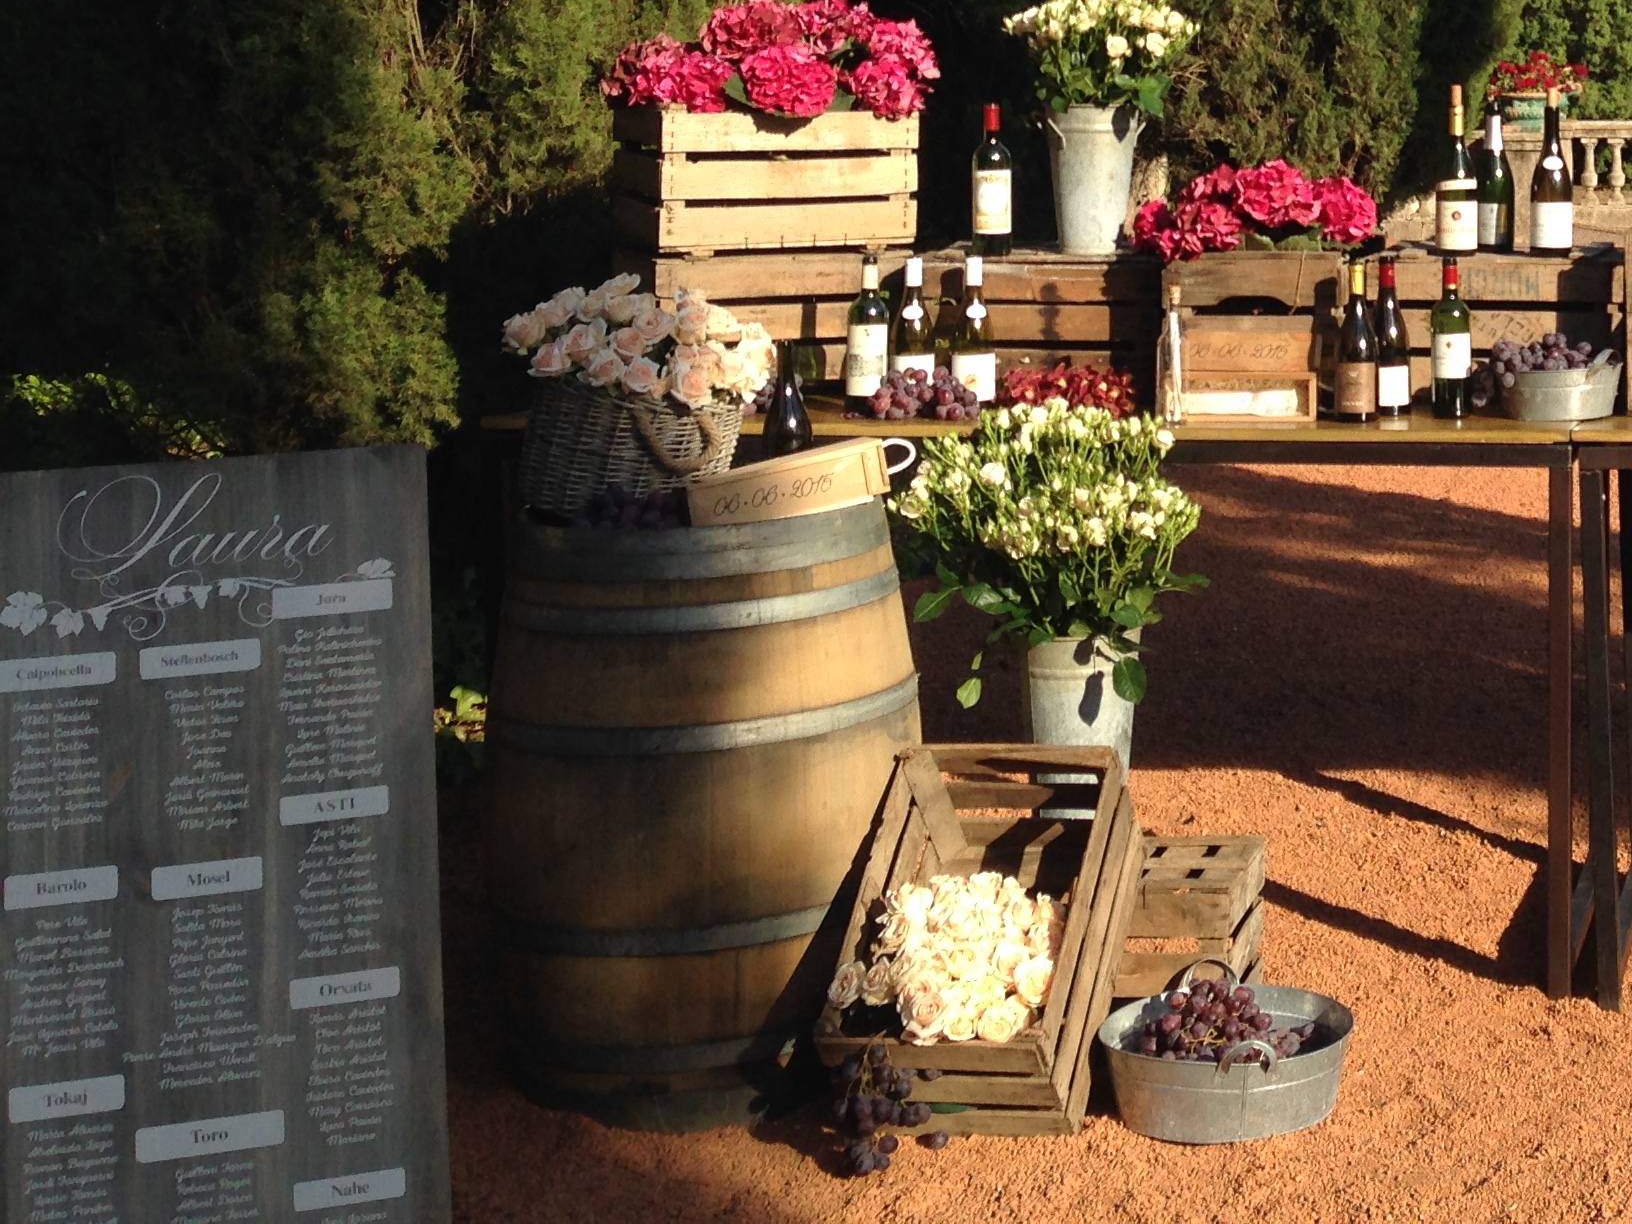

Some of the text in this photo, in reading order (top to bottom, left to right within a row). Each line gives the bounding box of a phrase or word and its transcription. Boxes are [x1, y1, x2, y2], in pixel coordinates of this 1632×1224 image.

[56, 472, 334, 580] Laura
[160, 650, 239, 667] Stellenbosch
[313, 797, 355, 814] ASTI
[36, 878, 88, 895] Barolo
[186, 870, 231, 886] Mosel
[319, 981, 373, 996] Orxata
[43, 1089, 88, 1107] Tokaj
[189, 1128, 229, 1144] Toro
[332, 1181, 370, 1198] Nahe
